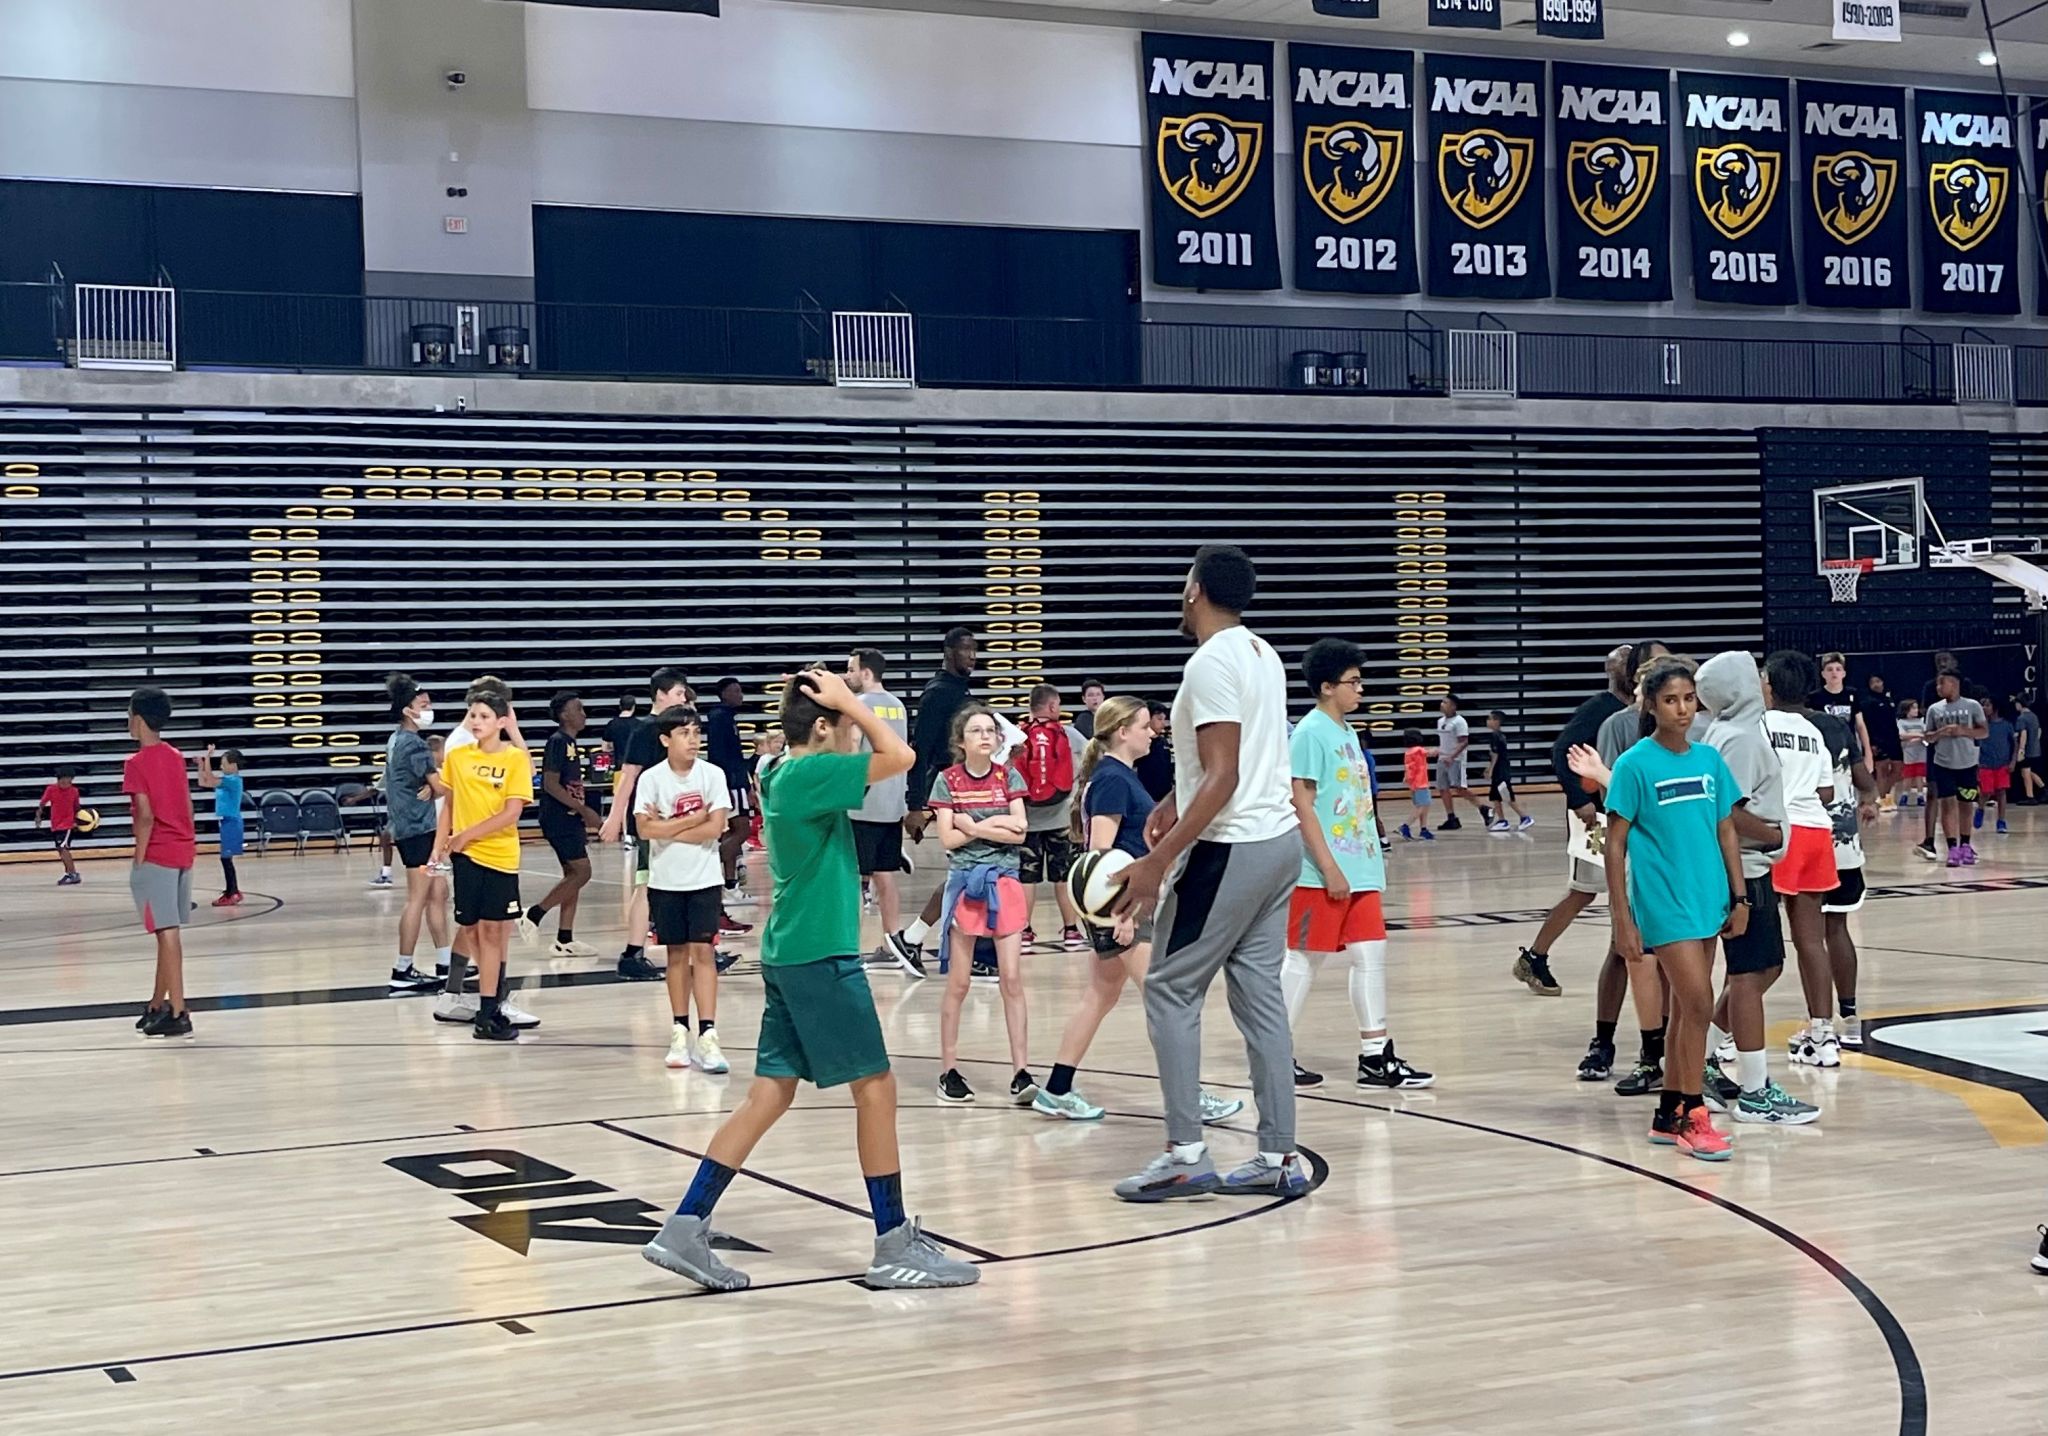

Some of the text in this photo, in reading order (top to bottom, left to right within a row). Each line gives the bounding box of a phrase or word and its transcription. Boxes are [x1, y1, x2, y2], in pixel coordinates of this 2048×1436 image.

[1543, 0, 1597, 23] 1990-1994
[1842, 2, 1894, 27] 1990-2009
[1149, 57, 1266, 101] NCAA
[1295, 67, 1407, 109] NCAA
[1430, 76, 1538, 118] NCAA
[1558, 85, 1662, 126] NCAA
[1685, 93, 1783, 133] NCAA
[1804, 102, 1898, 141] NCAA
[1921, 111, 2012, 149] NCAA
[1177, 230, 1253, 267] 2011
[1315, 236, 1398, 271] 2012
[1450, 243, 1528, 277] 2013
[1578, 246, 1651, 279] 2014
[1709, 250, 1778, 283] 2015
[1823, 256, 1892, 287] 2016
[1940, 262, 2005, 294] 2017
[472, 765, 506, 779] CU
